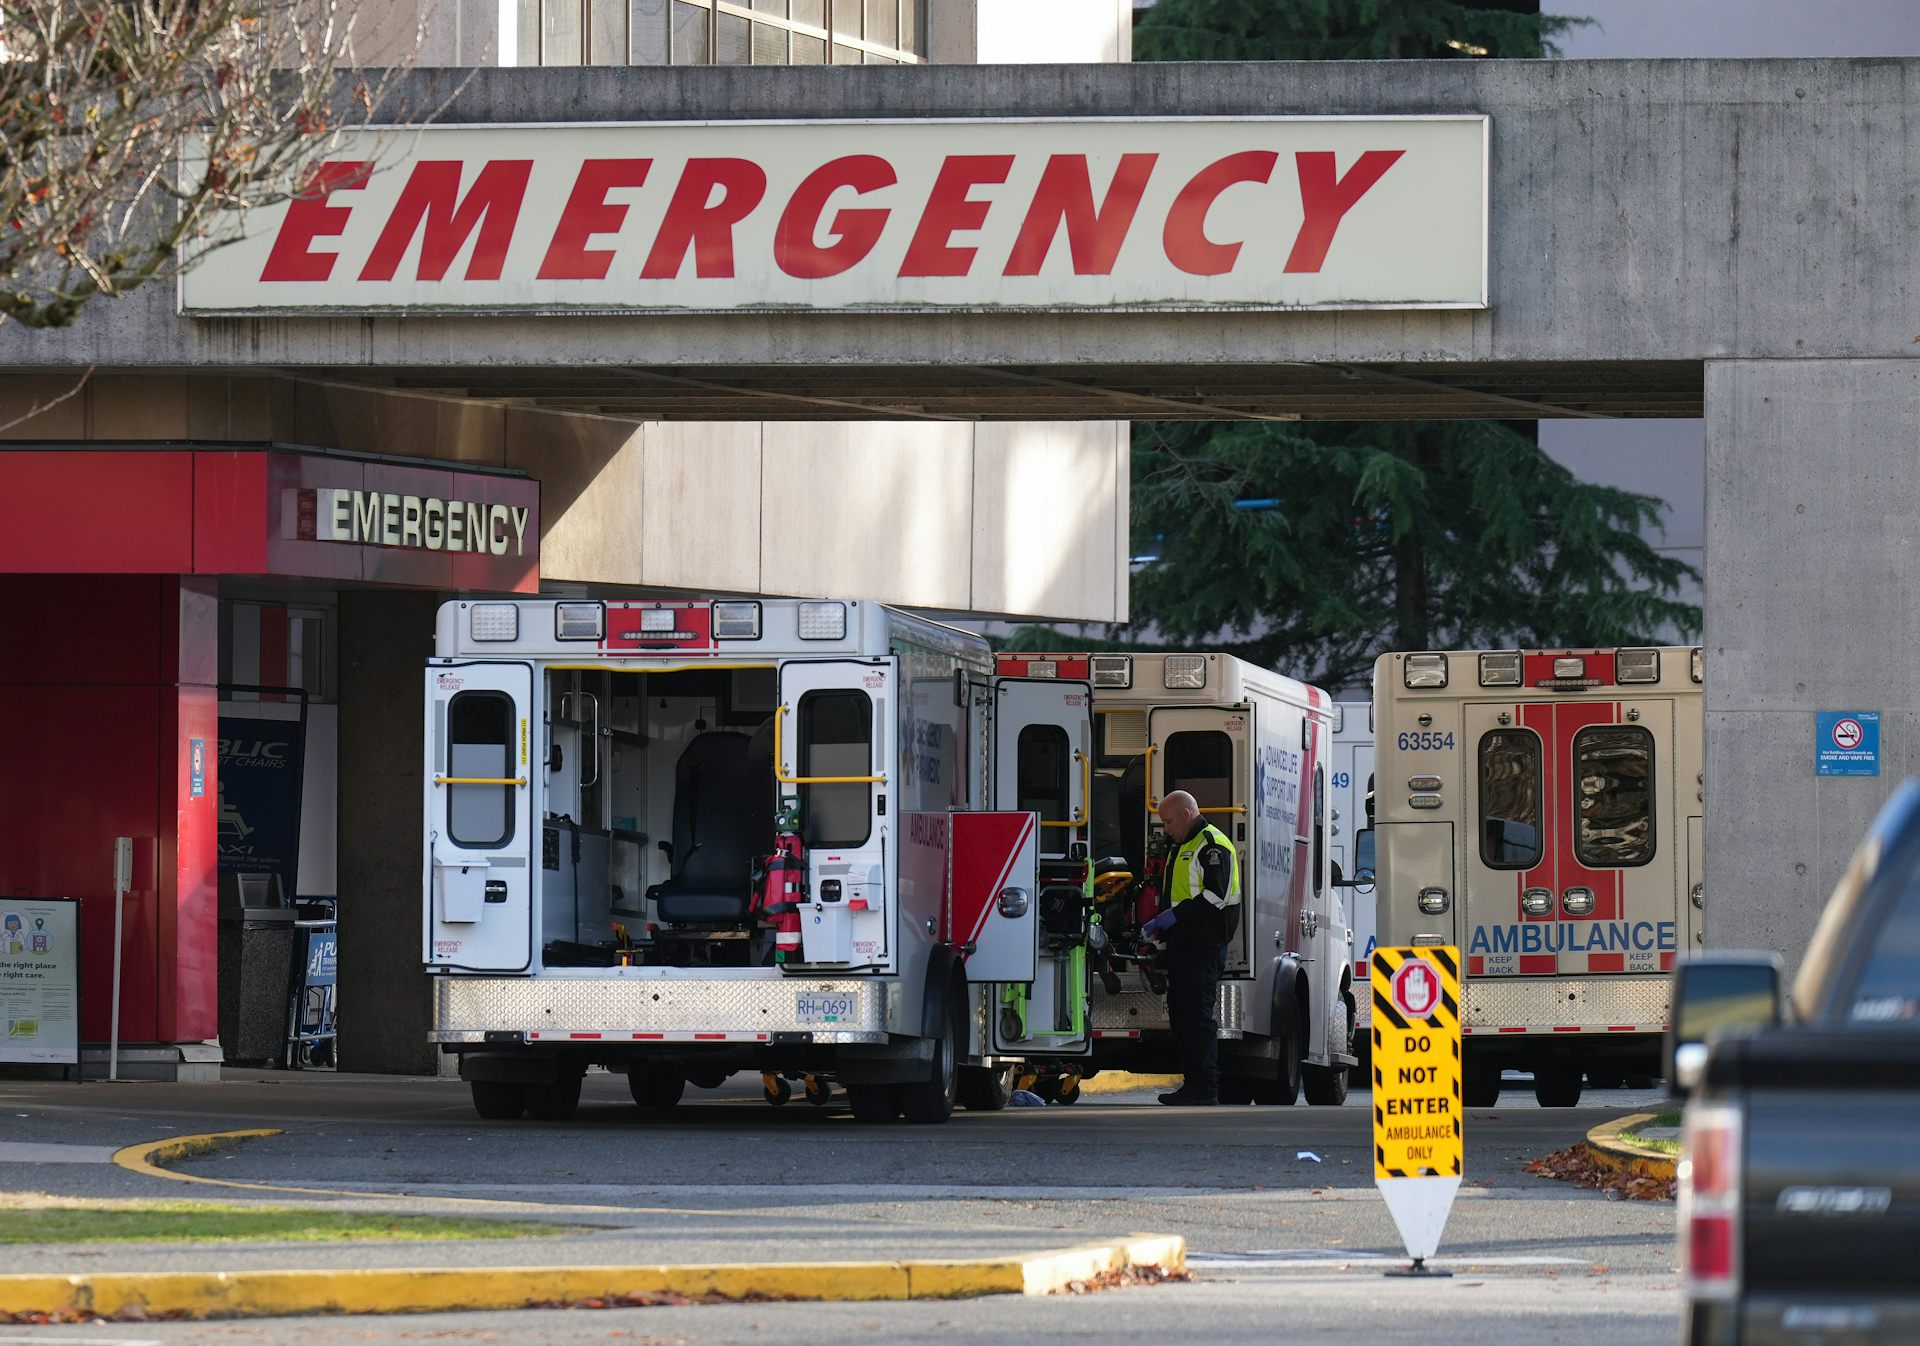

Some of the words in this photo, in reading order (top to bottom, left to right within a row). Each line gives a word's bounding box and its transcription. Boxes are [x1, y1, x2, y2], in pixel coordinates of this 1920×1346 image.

[259, 149, 1406, 282] EMERGENCY
[333, 489, 529, 556] EMERGENCY
[1398, 732, 1455, 750] 63554
[235, 757, 287, 769] CHAIRS
[1266, 745, 1288, 771] ADVANCED
[1288, 752, 1298, 775] LIFE
[1266, 776, 1286, 801] SUPPORT
[1286, 783, 1297, 805] UNIT
[1265, 804, 1281, 820] EMERGENCY
[911, 813, 944, 850] AMBULANCE
[1261, 840, 1290, 874] AMBULANCE
[1469, 921, 1675, 954] AMBULANCE
[13, 961, 33, 970] right
[35, 962, 57, 970] place
[1488, 956, 1512, 964] KEEP
[1629, 953, 1653, 961] KEEP
[3, 971, 23, 979] right
[1629, 963, 1654, 971] BACK
[1405, 1036, 1431, 1053] DO
[1399, 1067, 1438, 1084] NOT
[1387, 1098, 1449, 1115] ENTER
[1386, 1124, 1451, 1141] AMBULANCE
[1407, 1146, 1433, 1160] ONLY
